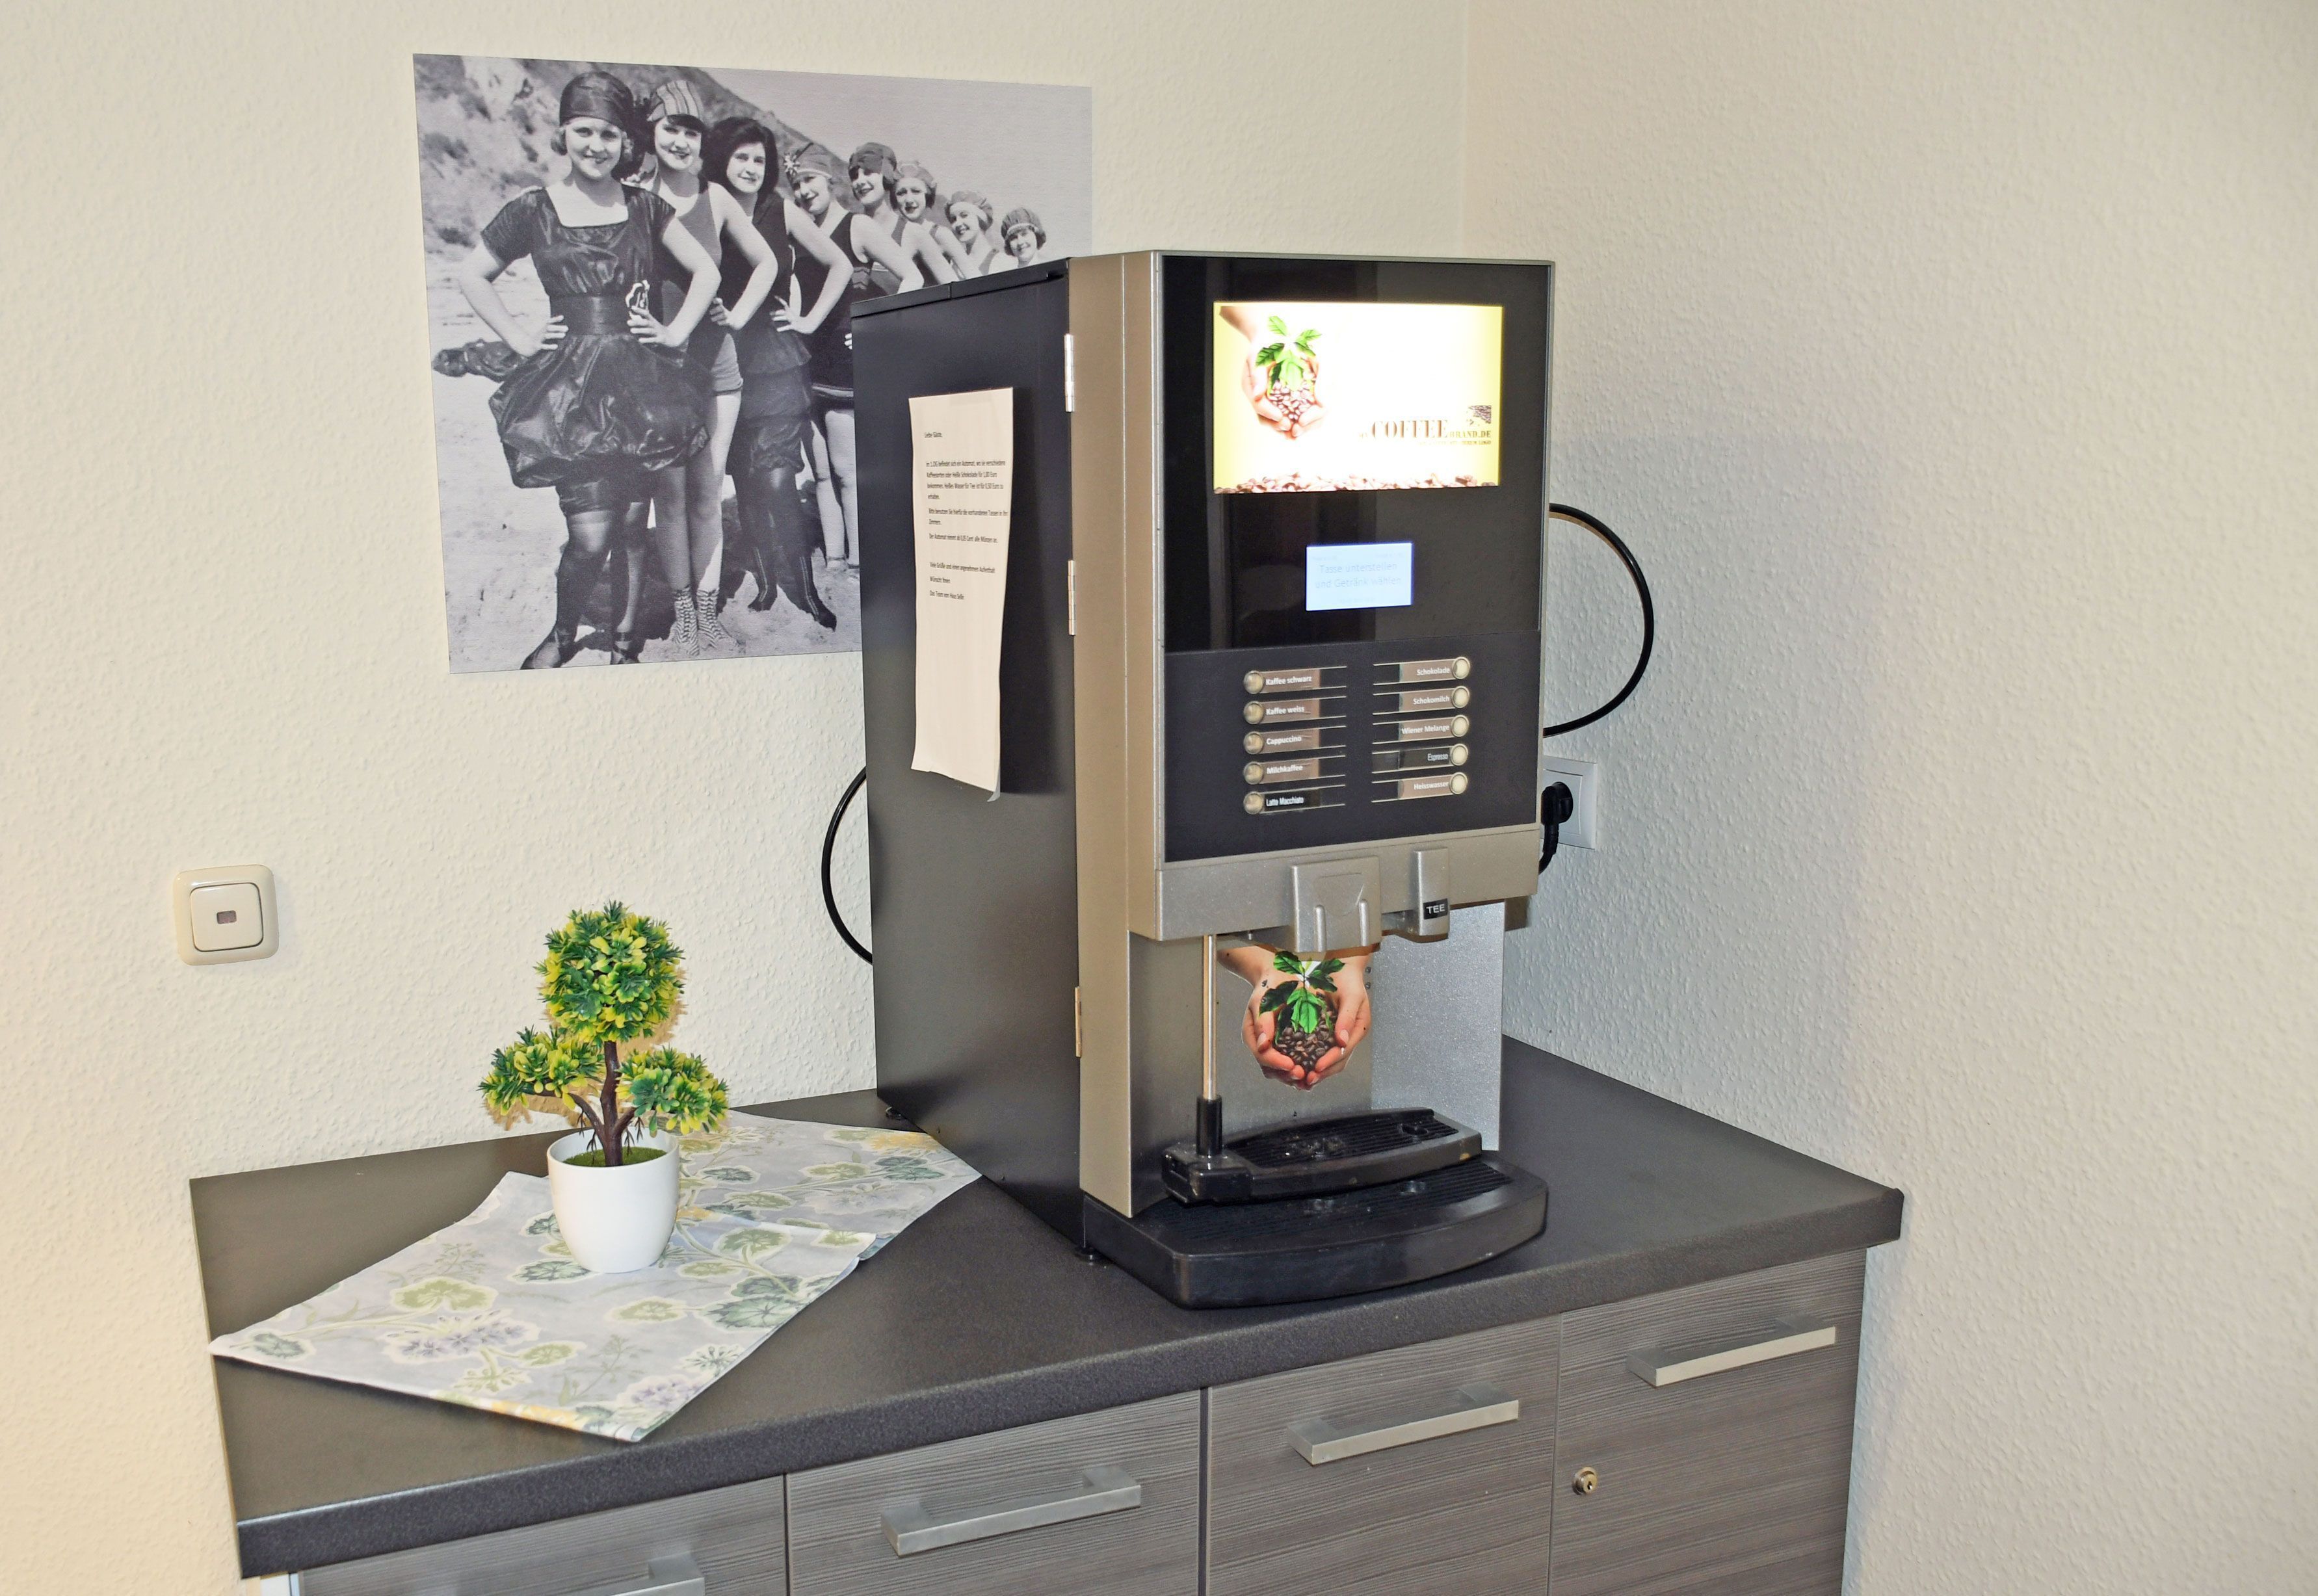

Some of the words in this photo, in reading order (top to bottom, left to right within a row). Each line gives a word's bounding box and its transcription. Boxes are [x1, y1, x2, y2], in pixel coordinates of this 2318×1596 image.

[1319, 565, 1343, 573] Tasse
[1417, 667, 1451, 676] Schokolade
[1413, 696, 1450, 705] Schokomilch
[1402, 726, 1423, 735] Wiener
[1424, 724, 1450, 733] Melange
[1266, 736, 1302, 745] Cappuccino
[1267, 765, 1303, 774] Milchkaffee
[1414, 781, 1449, 791] Heisswasser
[1266, 798, 1279, 807] Latte
[1279, 796, 1304, 805] Macchiato
[1426, 904, 1445, 914] TEE
